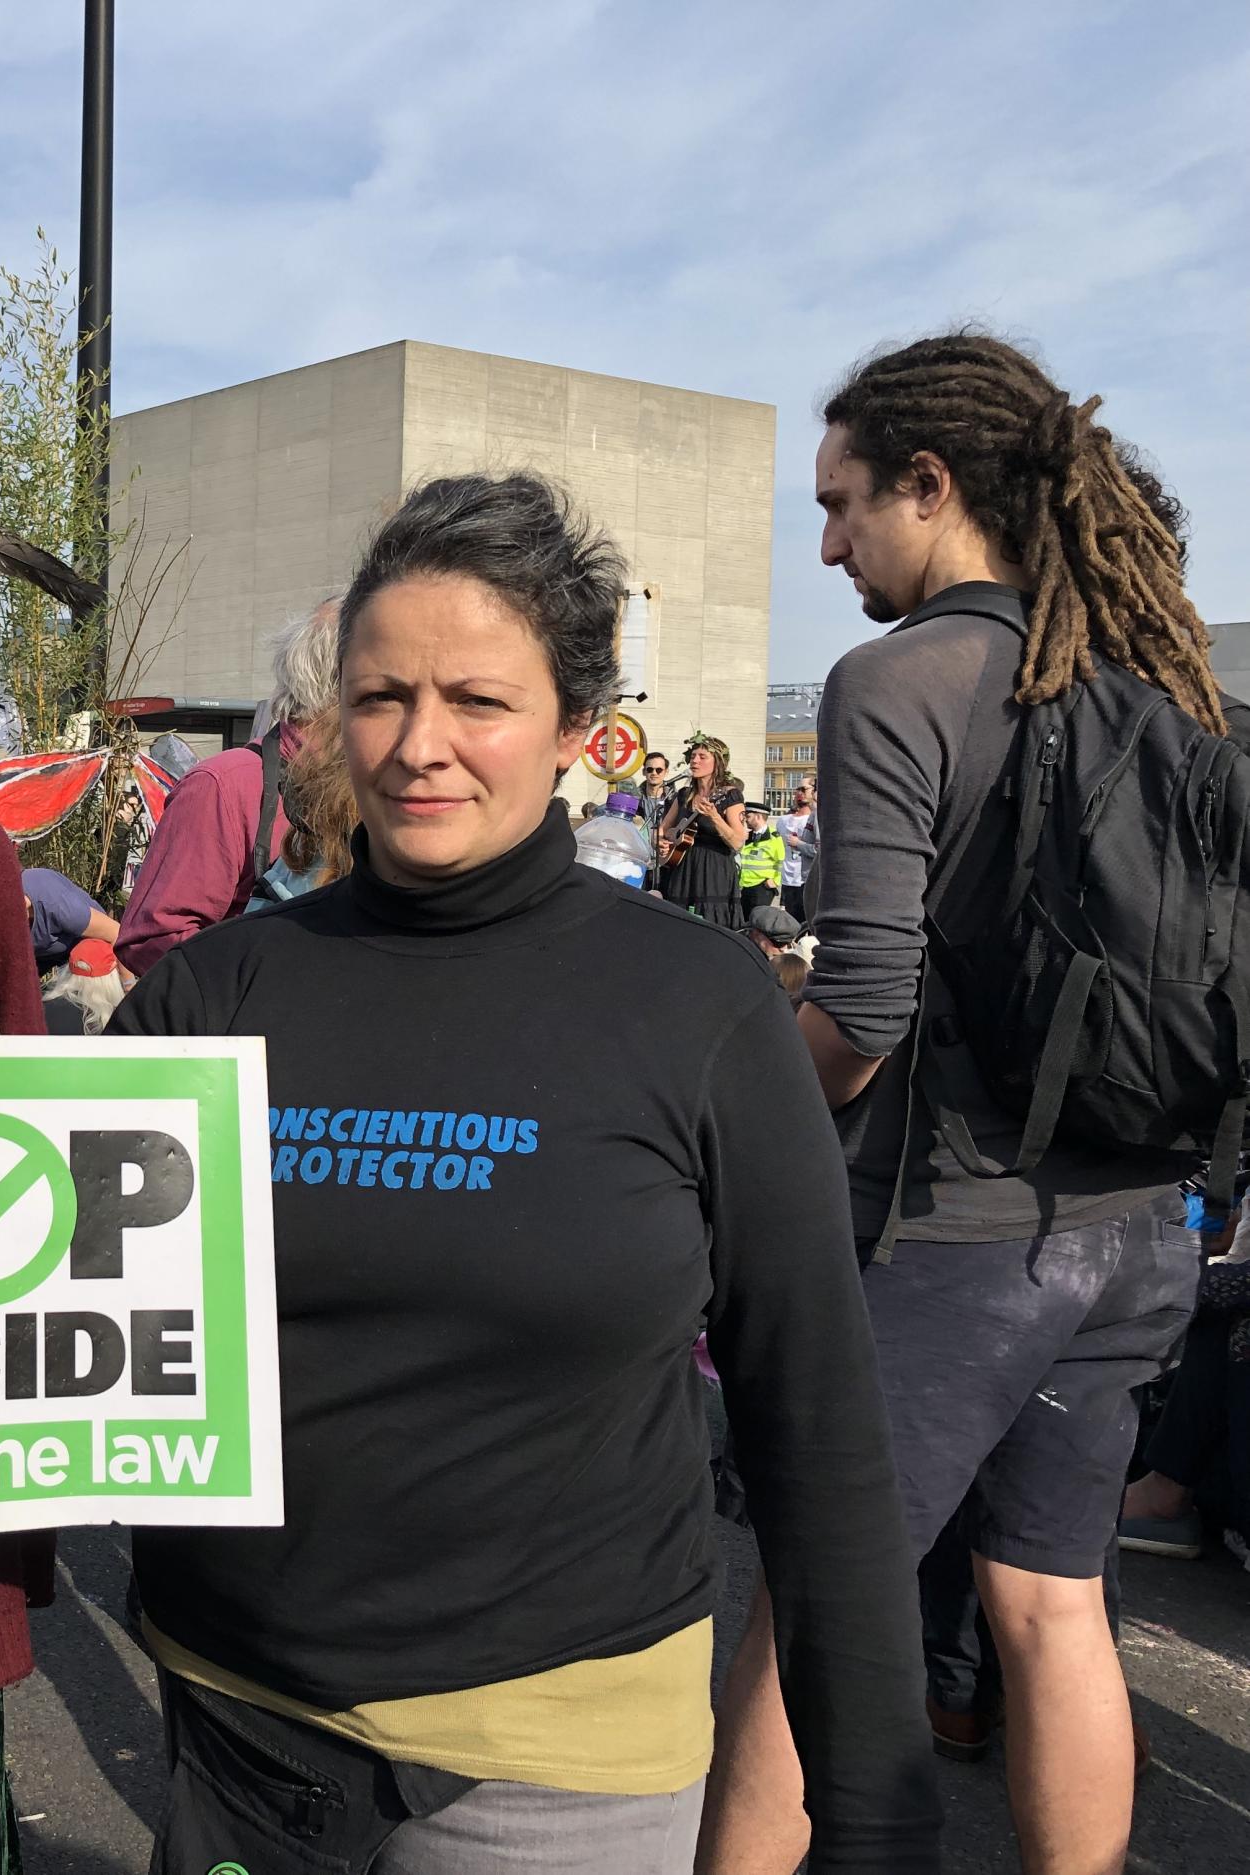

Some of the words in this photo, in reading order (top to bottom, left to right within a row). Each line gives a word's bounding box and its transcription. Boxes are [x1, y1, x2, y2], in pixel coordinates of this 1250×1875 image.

[269, 1107, 539, 1154] NSCIENTIOUS
[271, 1145, 495, 1190] ROTECTOR
[91, 1420, 220, 1484] law
